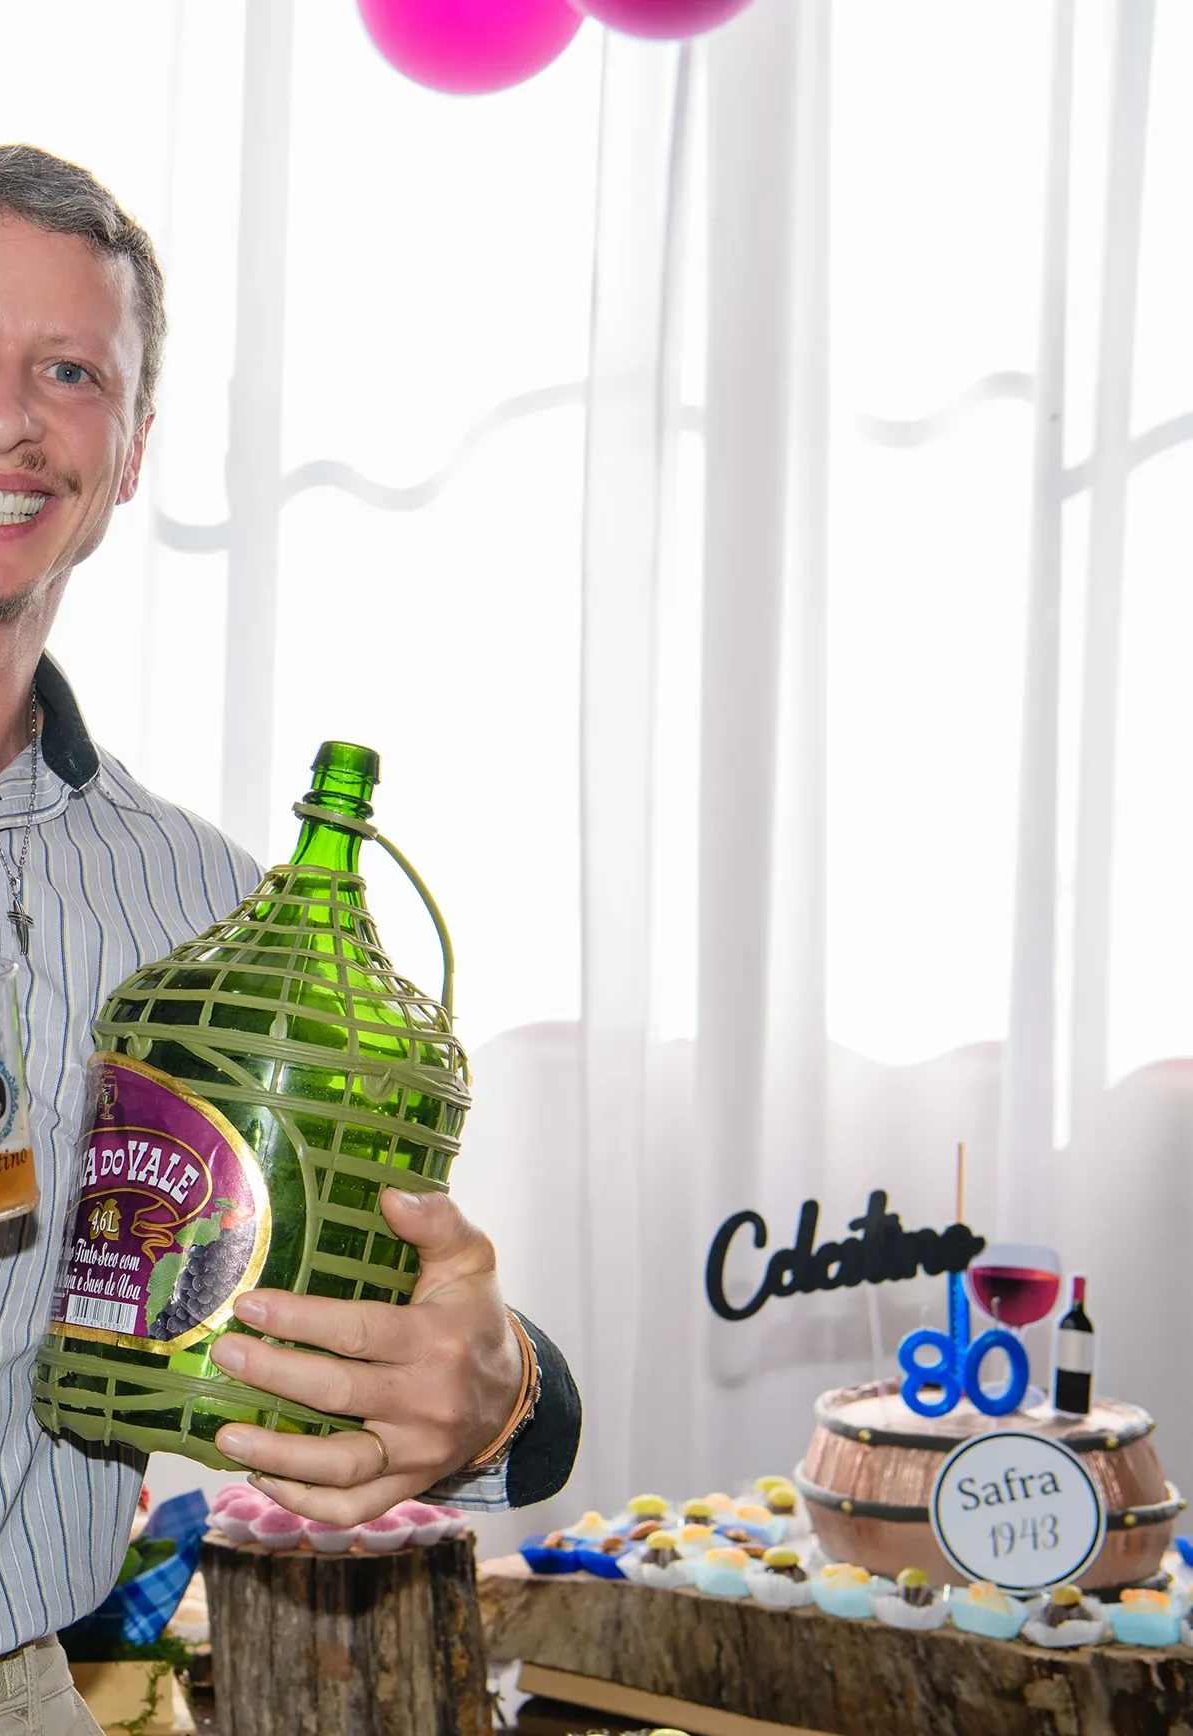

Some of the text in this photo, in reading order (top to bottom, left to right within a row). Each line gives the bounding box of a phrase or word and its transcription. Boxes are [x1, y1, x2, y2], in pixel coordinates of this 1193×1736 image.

[100, 1148, 125, 1177] DO
[127, 1140, 200, 1205] VALE
[74, 1237, 98, 1265] Tinto
[97, 1242, 118, 1269] Seco
[119, 1254, 141, 1272] com
[77, 1275, 83, 1291] e
[83, 1268, 104, 1295] Suco
[104, 1271, 116, 1297] de
[897, 1328, 1030, 1418] 80
[956, 1466, 1062, 1513] Safra
[987, 1513, 1060, 1558] 1943
